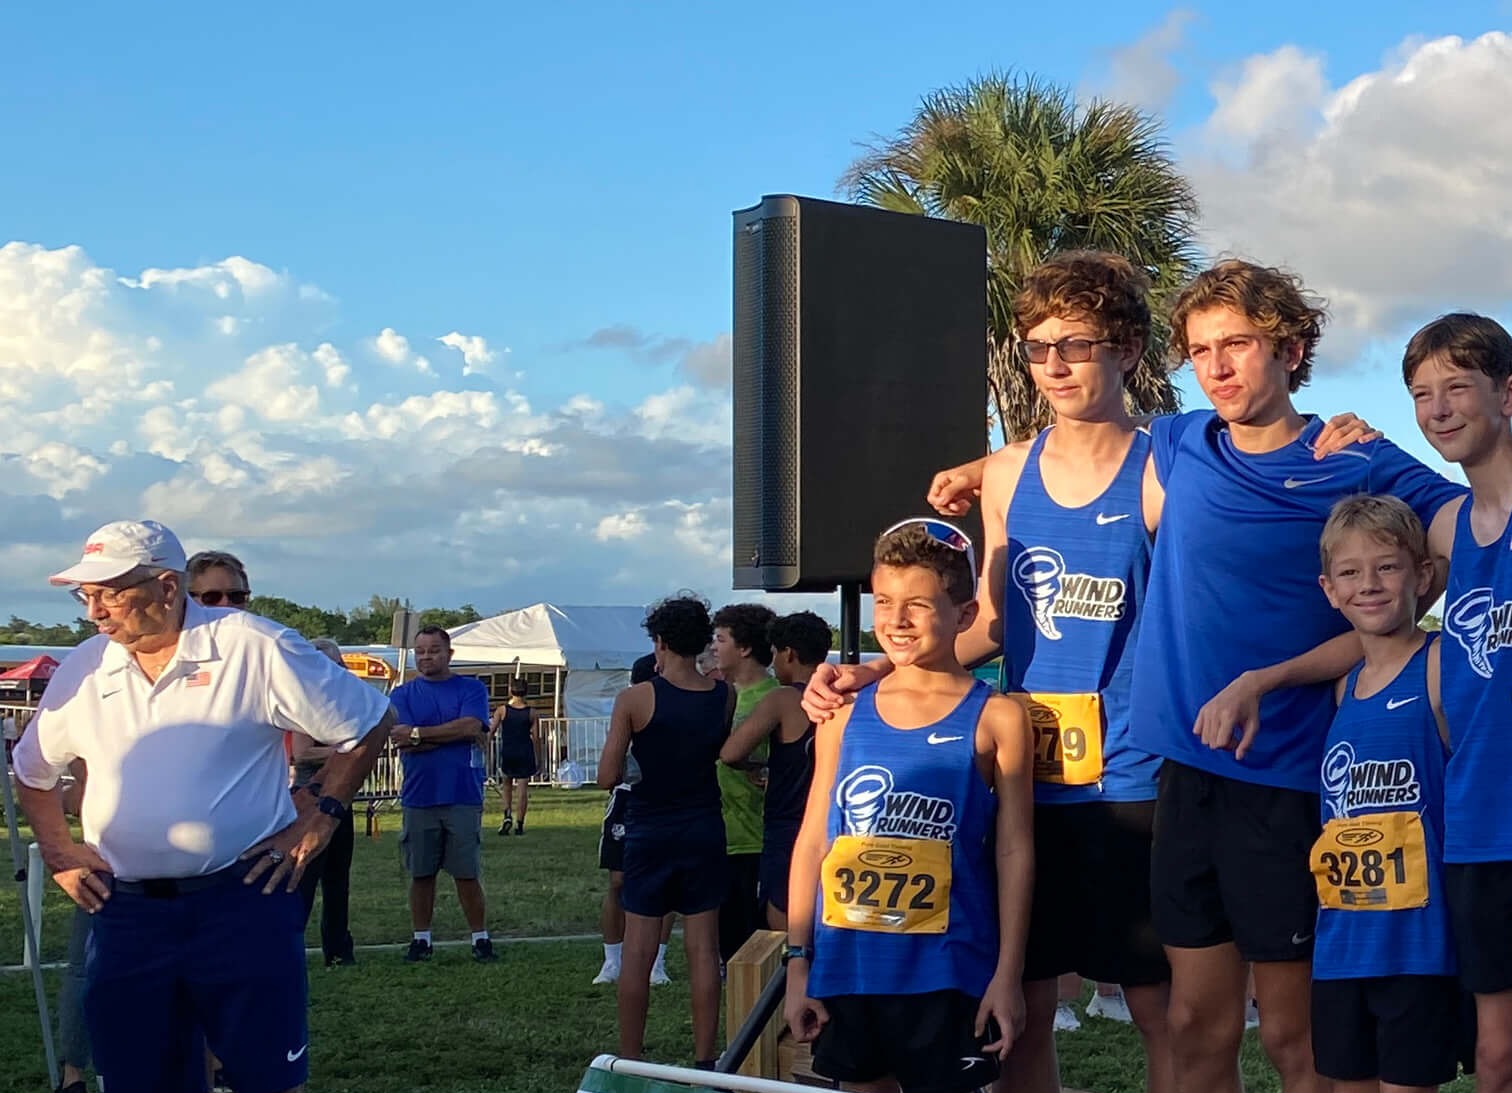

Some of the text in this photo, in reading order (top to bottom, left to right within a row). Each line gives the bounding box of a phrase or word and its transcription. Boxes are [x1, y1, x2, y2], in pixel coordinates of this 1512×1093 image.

[1061, 576, 1123, 603] WIND
[1053, 599, 1125, 618] RUNNERS
[1350, 761, 1412, 790] WIND
[885, 794, 953, 823] WIND
[1347, 784, 1419, 808] RUNNERS
[876, 818, 954, 840] RUNNERS
[1320, 847, 1406, 887] 3281
[833, 867, 936, 910] 3272
